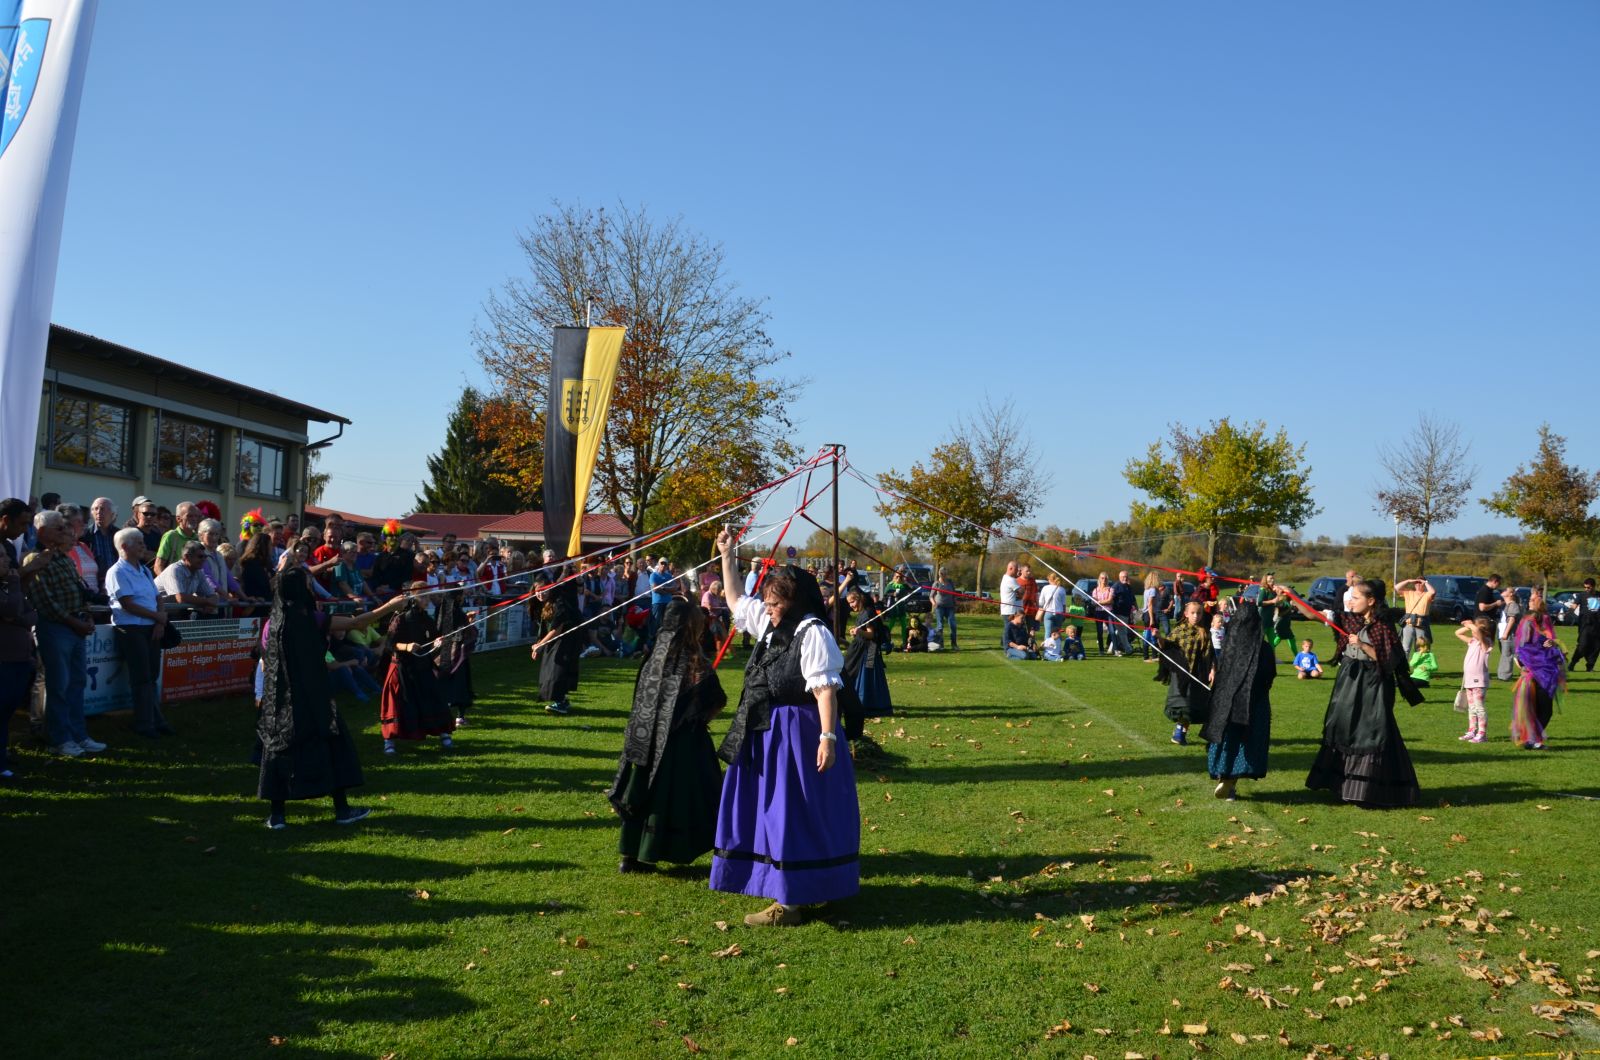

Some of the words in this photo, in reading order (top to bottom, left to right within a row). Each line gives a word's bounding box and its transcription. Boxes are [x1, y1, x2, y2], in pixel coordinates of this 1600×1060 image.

[204, 643, 217, 651] man
[167, 657, 187, 667] Reifen
[193, 655, 213, 666] Felgen
